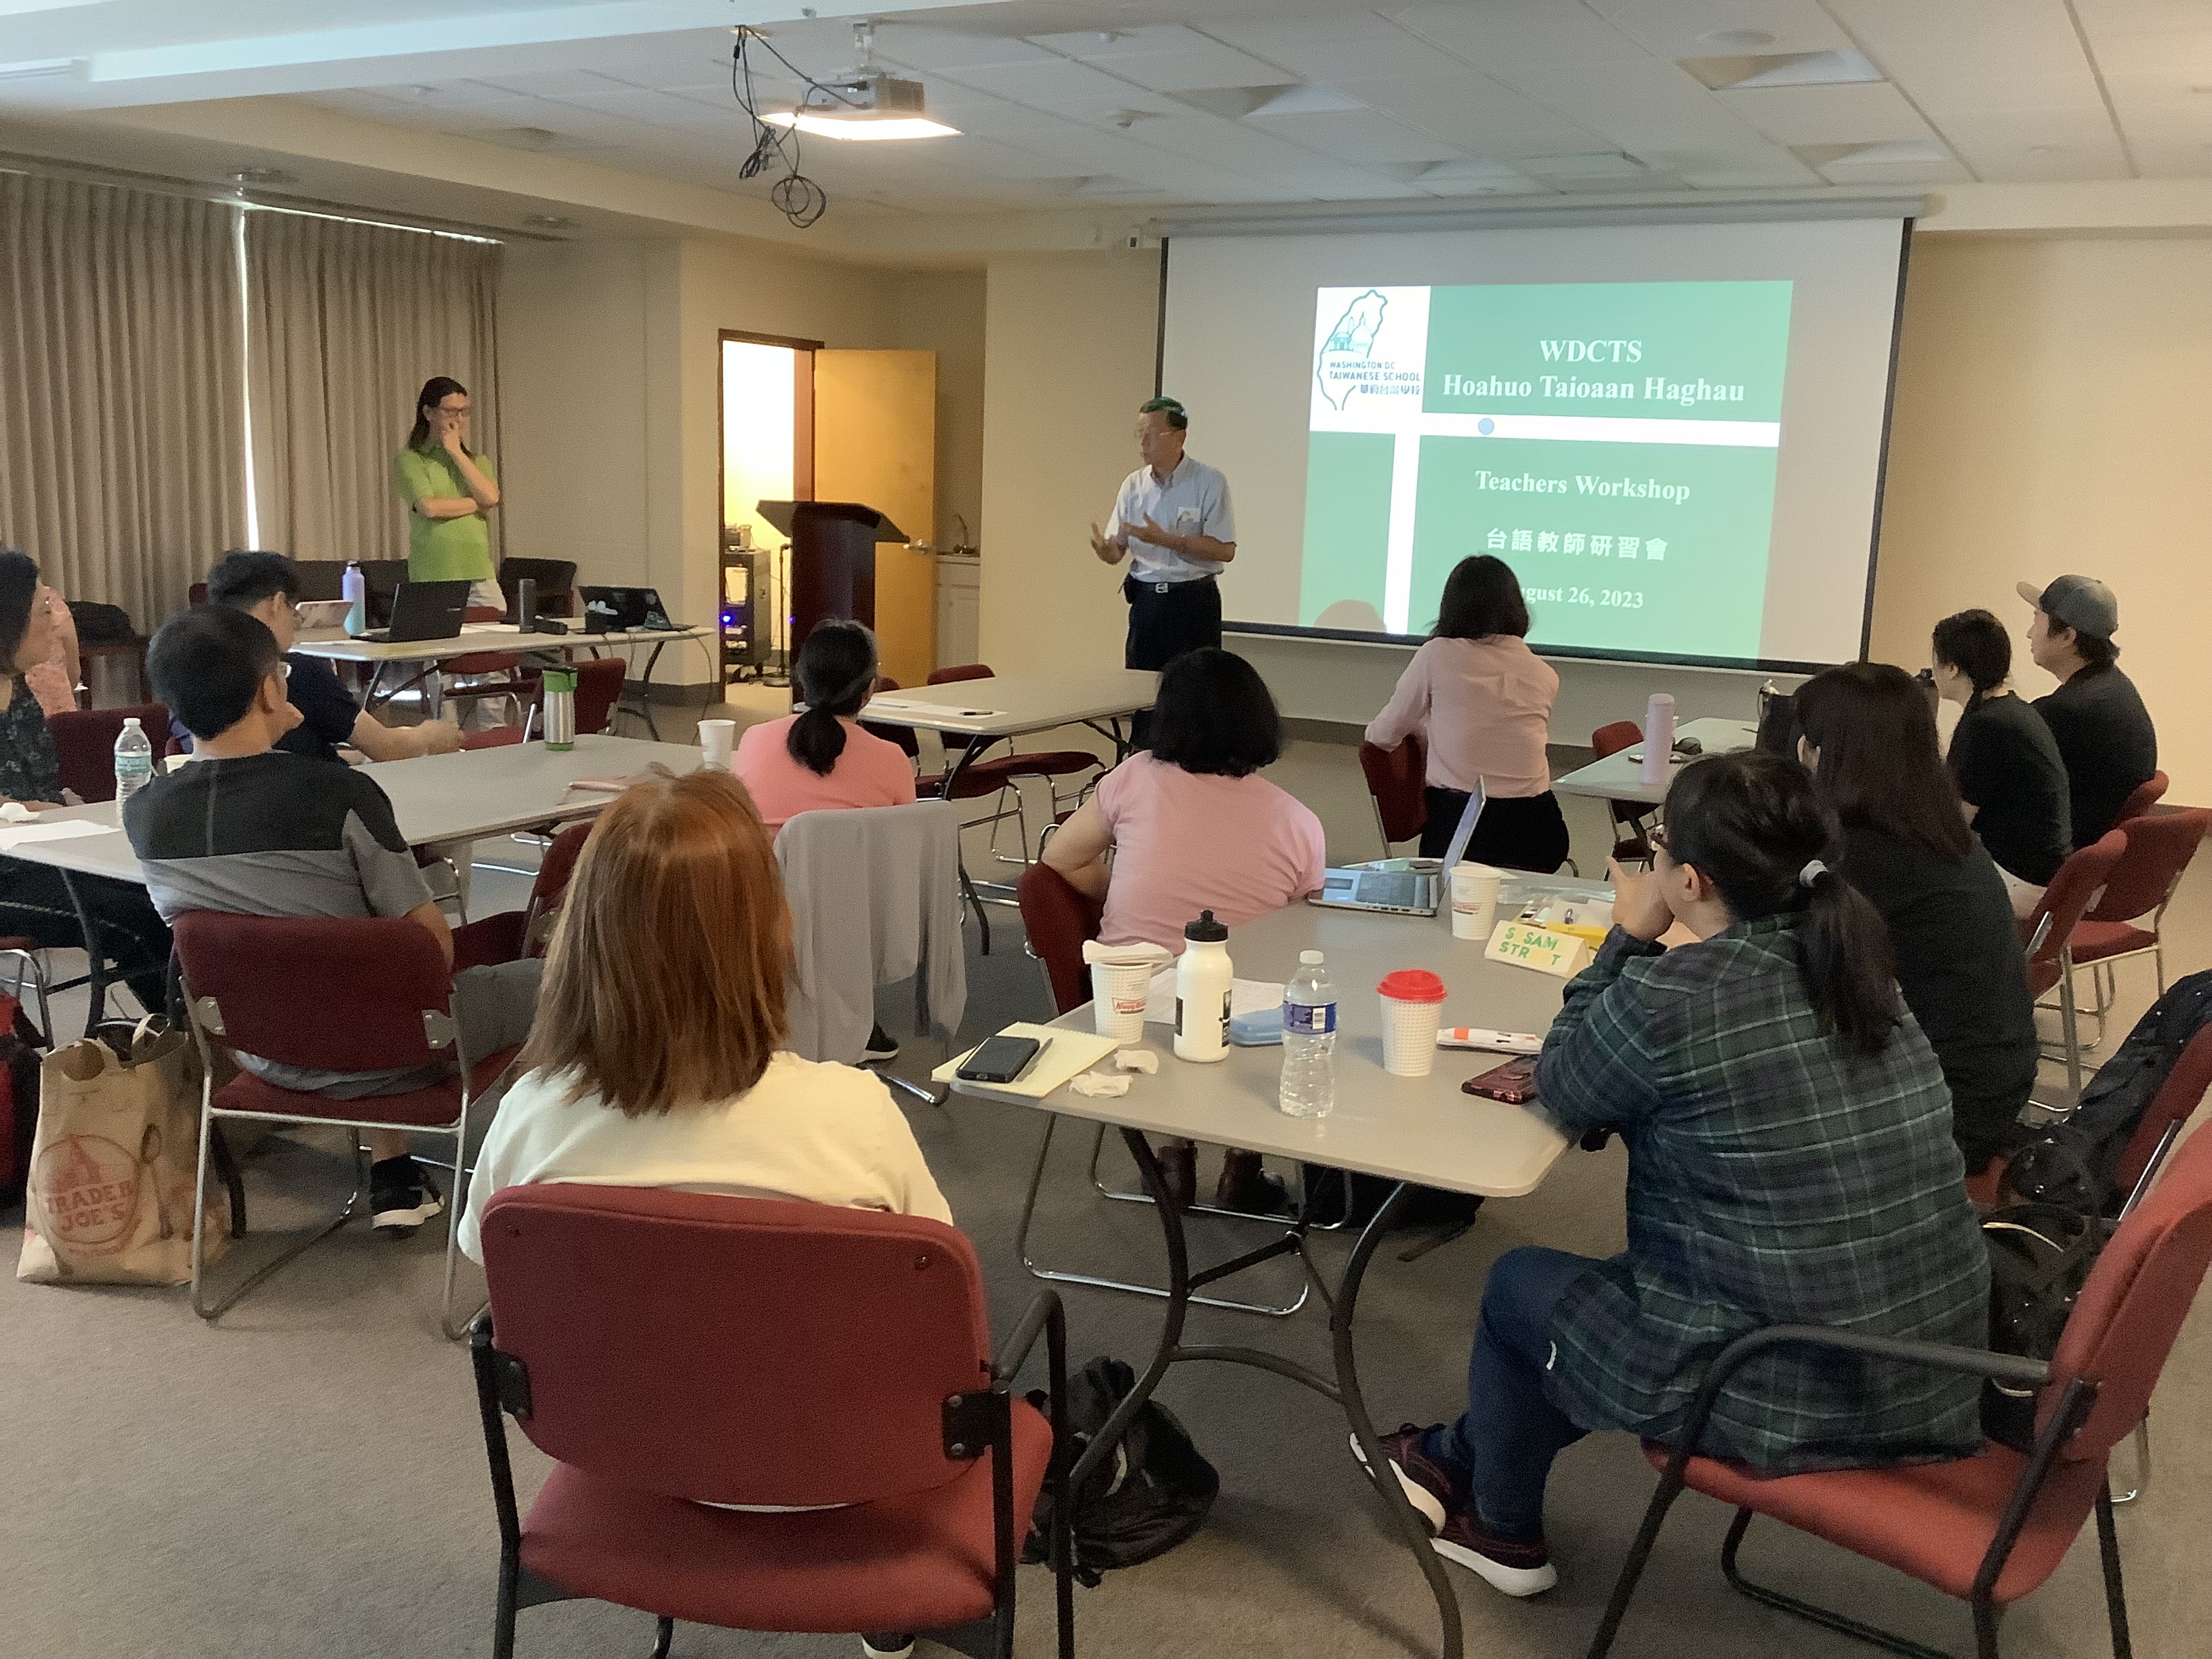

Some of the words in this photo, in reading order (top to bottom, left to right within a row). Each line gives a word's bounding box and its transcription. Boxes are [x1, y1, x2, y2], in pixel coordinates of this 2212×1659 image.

[1540, 340, 1643, 363] WDCTS
[1330, 371, 1380, 380] TAIWANESE
[1383, 372, 1420, 381] SCHOOL
[1443, 374, 1532, 396] Hoahuo
[1540, 375, 1634, 398] Taioaan
[1643, 377, 1744, 406] Haghau
[1475, 470, 1567, 493] Teachers
[1575, 475, 1690, 505] Workshop
[1487, 527, 1668, 561] 台語教師研習會
[1520, 587, 1563, 604] gust
[1568, 587, 1595, 607] 26,
[1600, 589, 1643, 609] 2023
